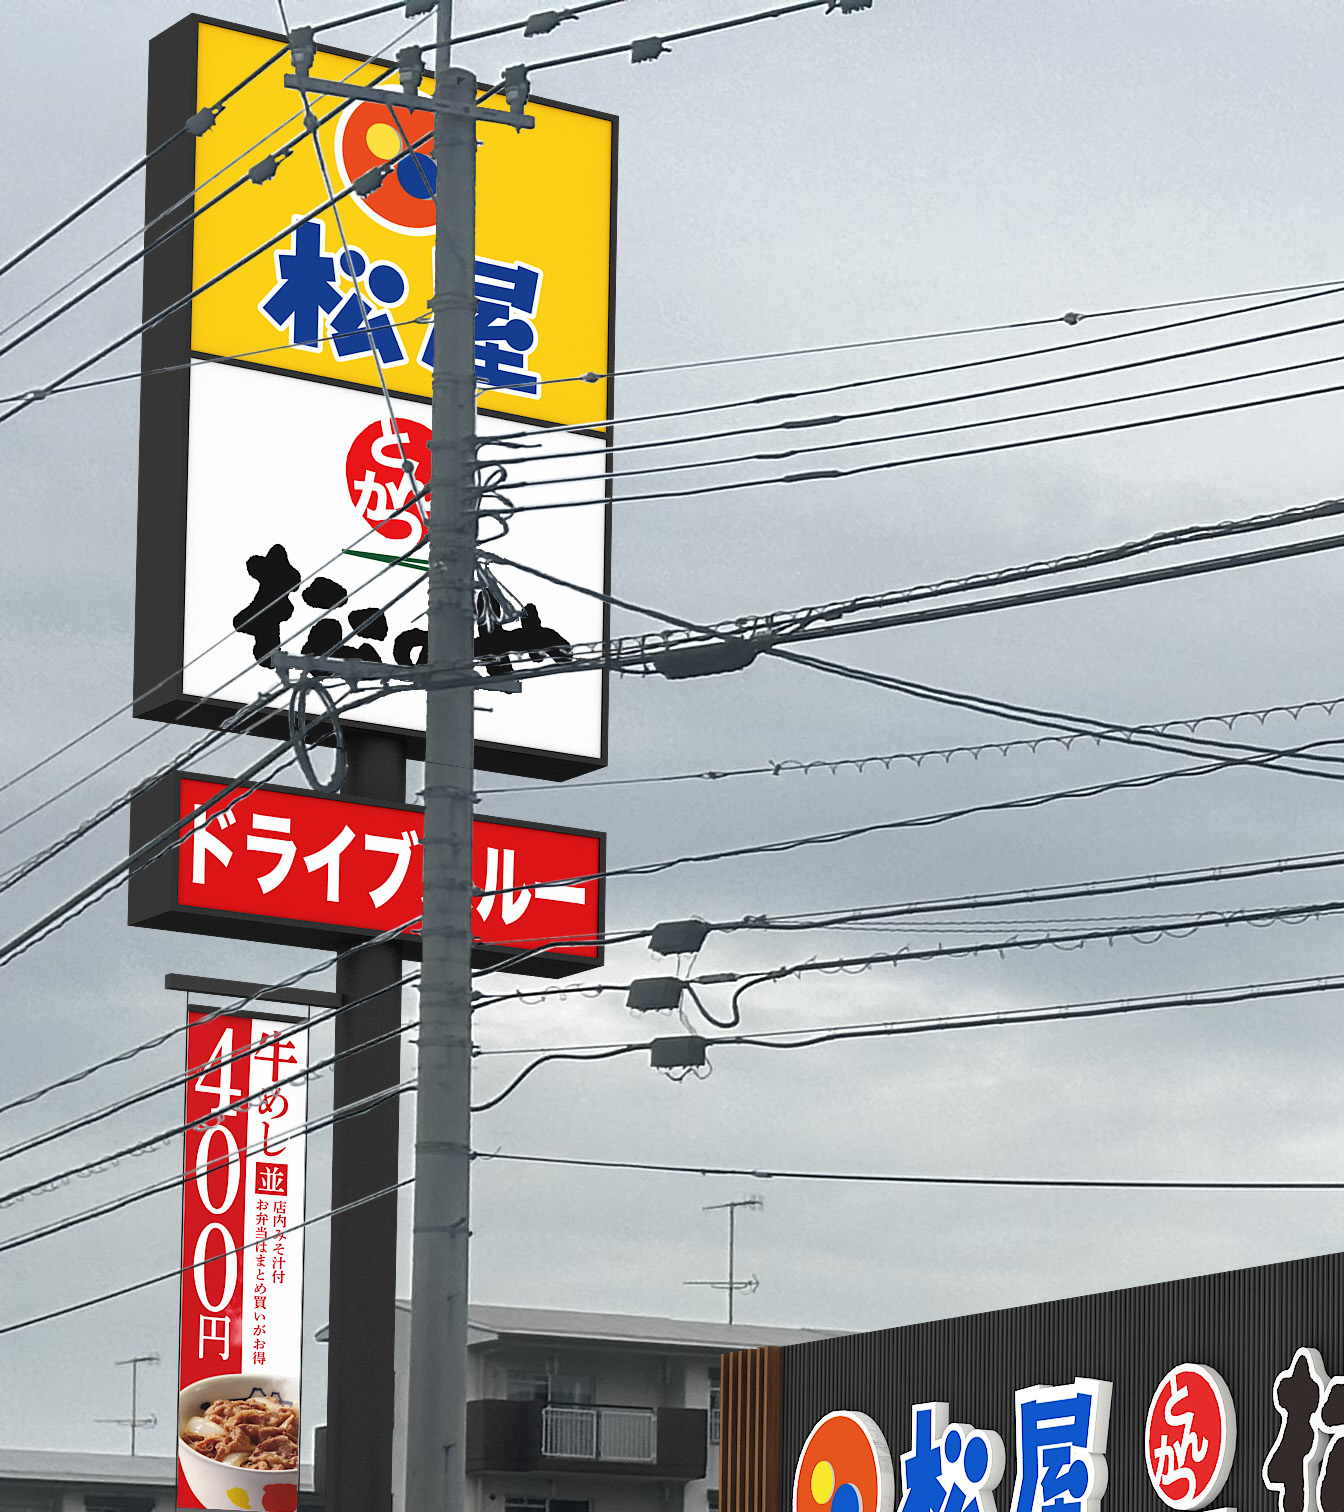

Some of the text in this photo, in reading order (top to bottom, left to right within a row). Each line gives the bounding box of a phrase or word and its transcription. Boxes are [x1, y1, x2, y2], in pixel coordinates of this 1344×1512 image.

[262, 216, 542, 398] 松屋
[191, 803, 586, 925] ドライブルー
[194, 1027, 241, 1361] 400円
[272, 1200, 288, 1284] 店内みそ汁付
[253, 1199, 269, 1366] お弁当はまとめ買いがお得
